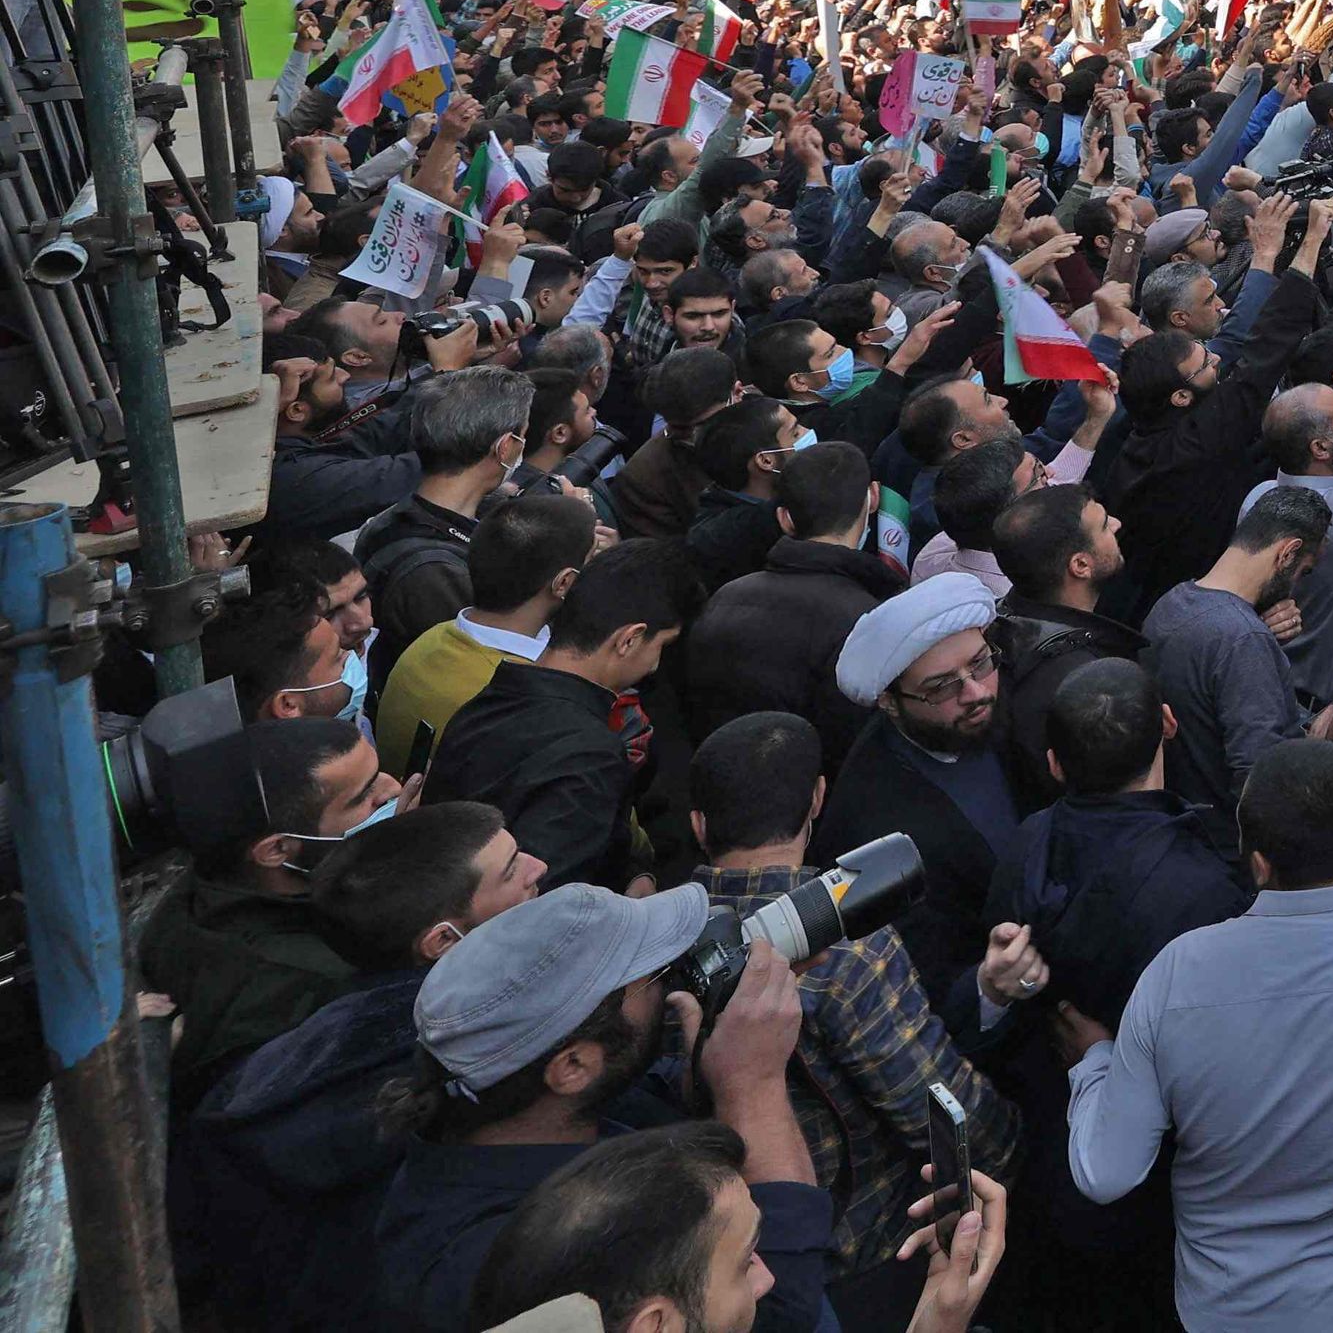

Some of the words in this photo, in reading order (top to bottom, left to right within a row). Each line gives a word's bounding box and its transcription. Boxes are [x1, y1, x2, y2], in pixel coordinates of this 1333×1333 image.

[606, 22, 619, 33] WE
[622, 11, 638, 24] ARE
[631, 18, 648, 28] THE
[367, 199, 405, 274] #ایران_قوی
[398, 211, 425, 282] #ایران_من
